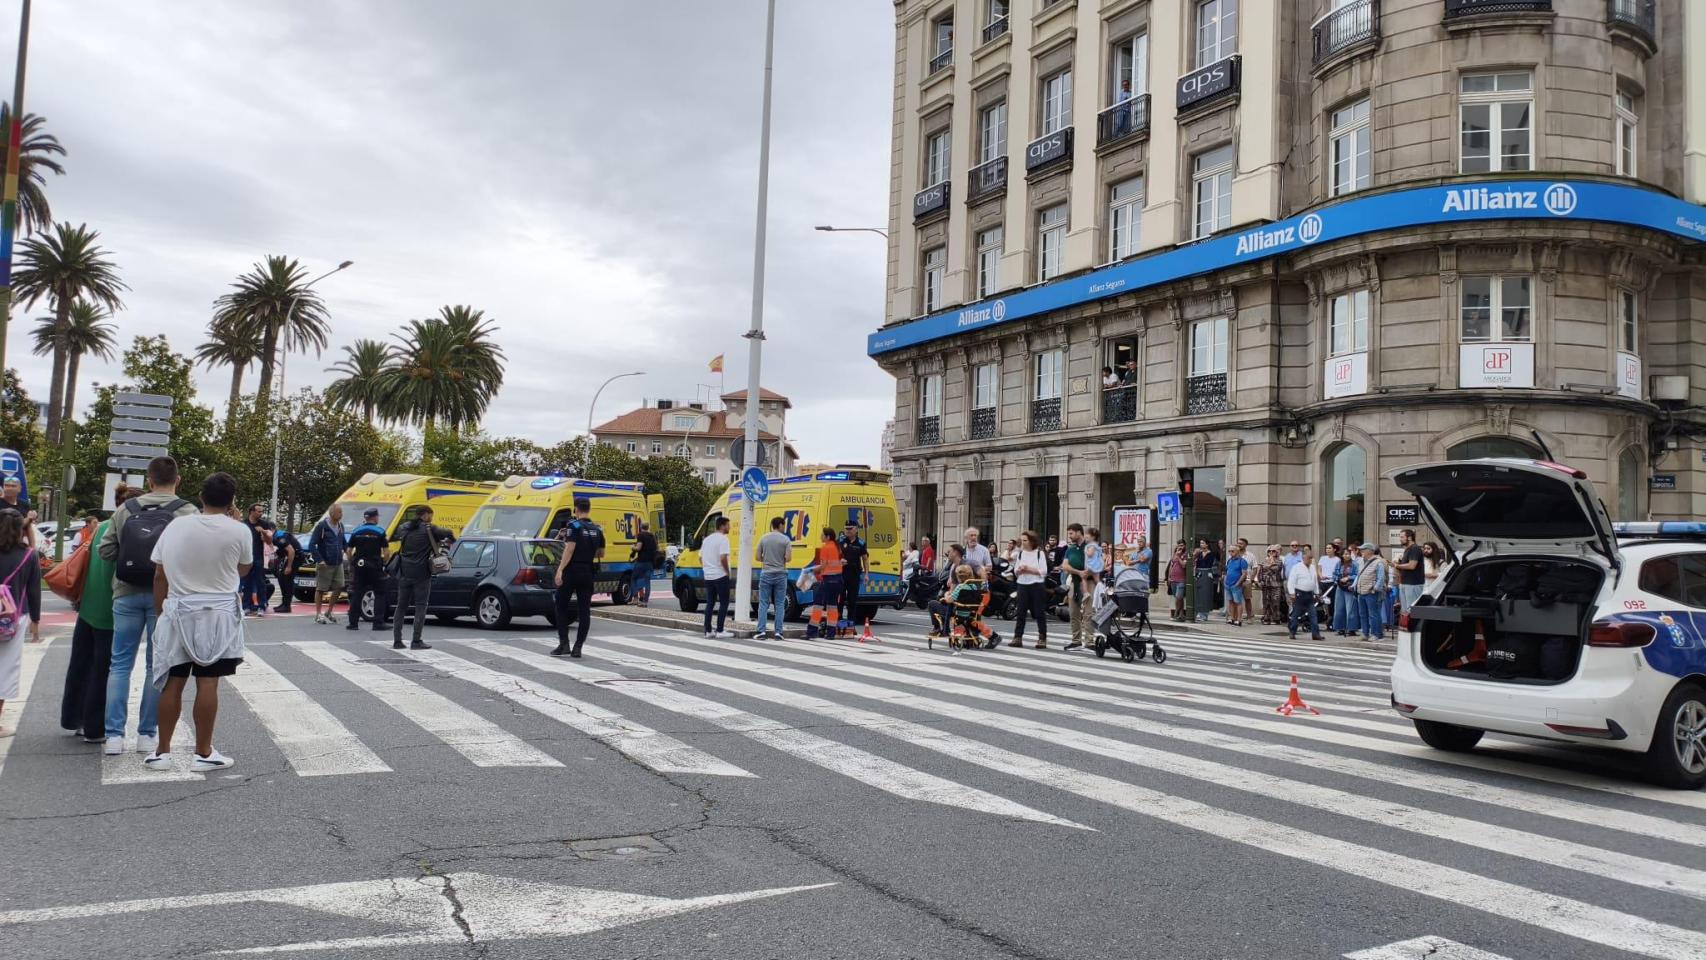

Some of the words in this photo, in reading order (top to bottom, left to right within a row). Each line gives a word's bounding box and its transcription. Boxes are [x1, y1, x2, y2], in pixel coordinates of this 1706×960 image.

[1182, 66, 1224, 93] aps
[1030, 136, 1061, 157] aps
[916, 188, 941, 206] aps
[1442, 188, 1538, 213] Allianz
[1236, 226, 1295, 256] Allianz
[957, 307, 991, 328] Allianz
[840, 495, 886, 504] AMBULANCIA
[1160, 496, 1174, 518] P
[1119, 513, 1147, 532] BURGERS
[1389, 508, 1416, 517] aps
[873, 533, 893, 543] SVB
[1623, 600, 1647, 610] 092
